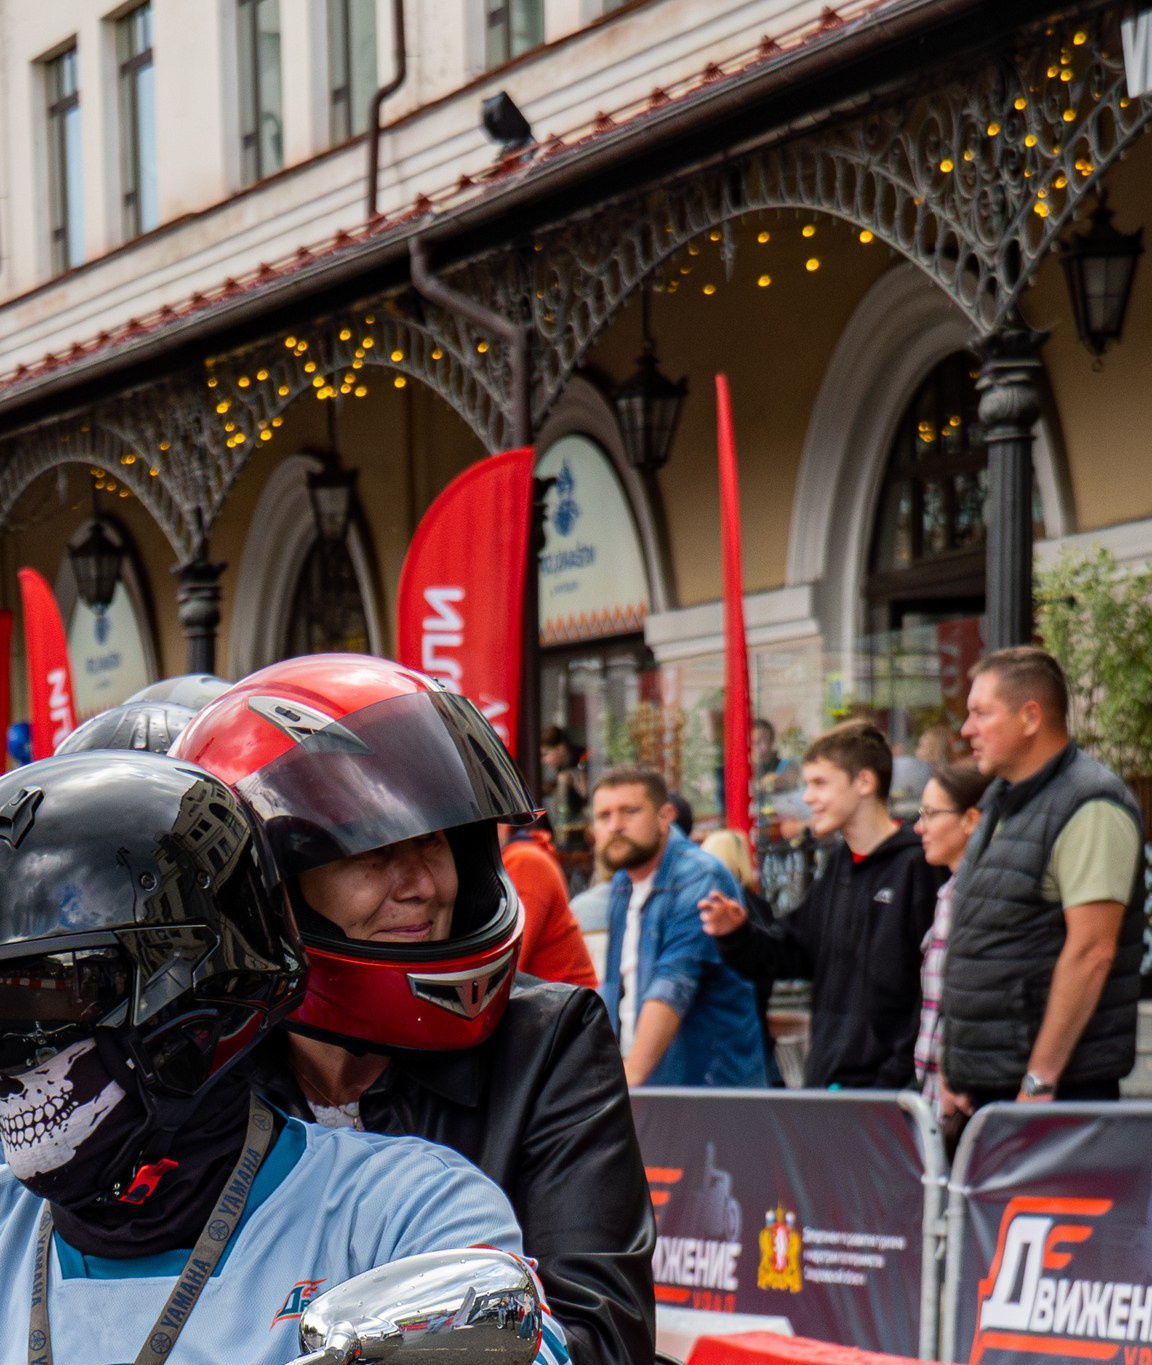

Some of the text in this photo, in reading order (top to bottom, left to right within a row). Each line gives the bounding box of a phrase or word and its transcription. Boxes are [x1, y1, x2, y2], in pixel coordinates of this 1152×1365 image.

[218, 1148, 261, 1218] YAMAHA
[31, 1233, 50, 1307] YAMAHA
[160, 1258, 212, 1330] YAMAHA
[652, 1236, 743, 1291] ИЖЕНИЕ
